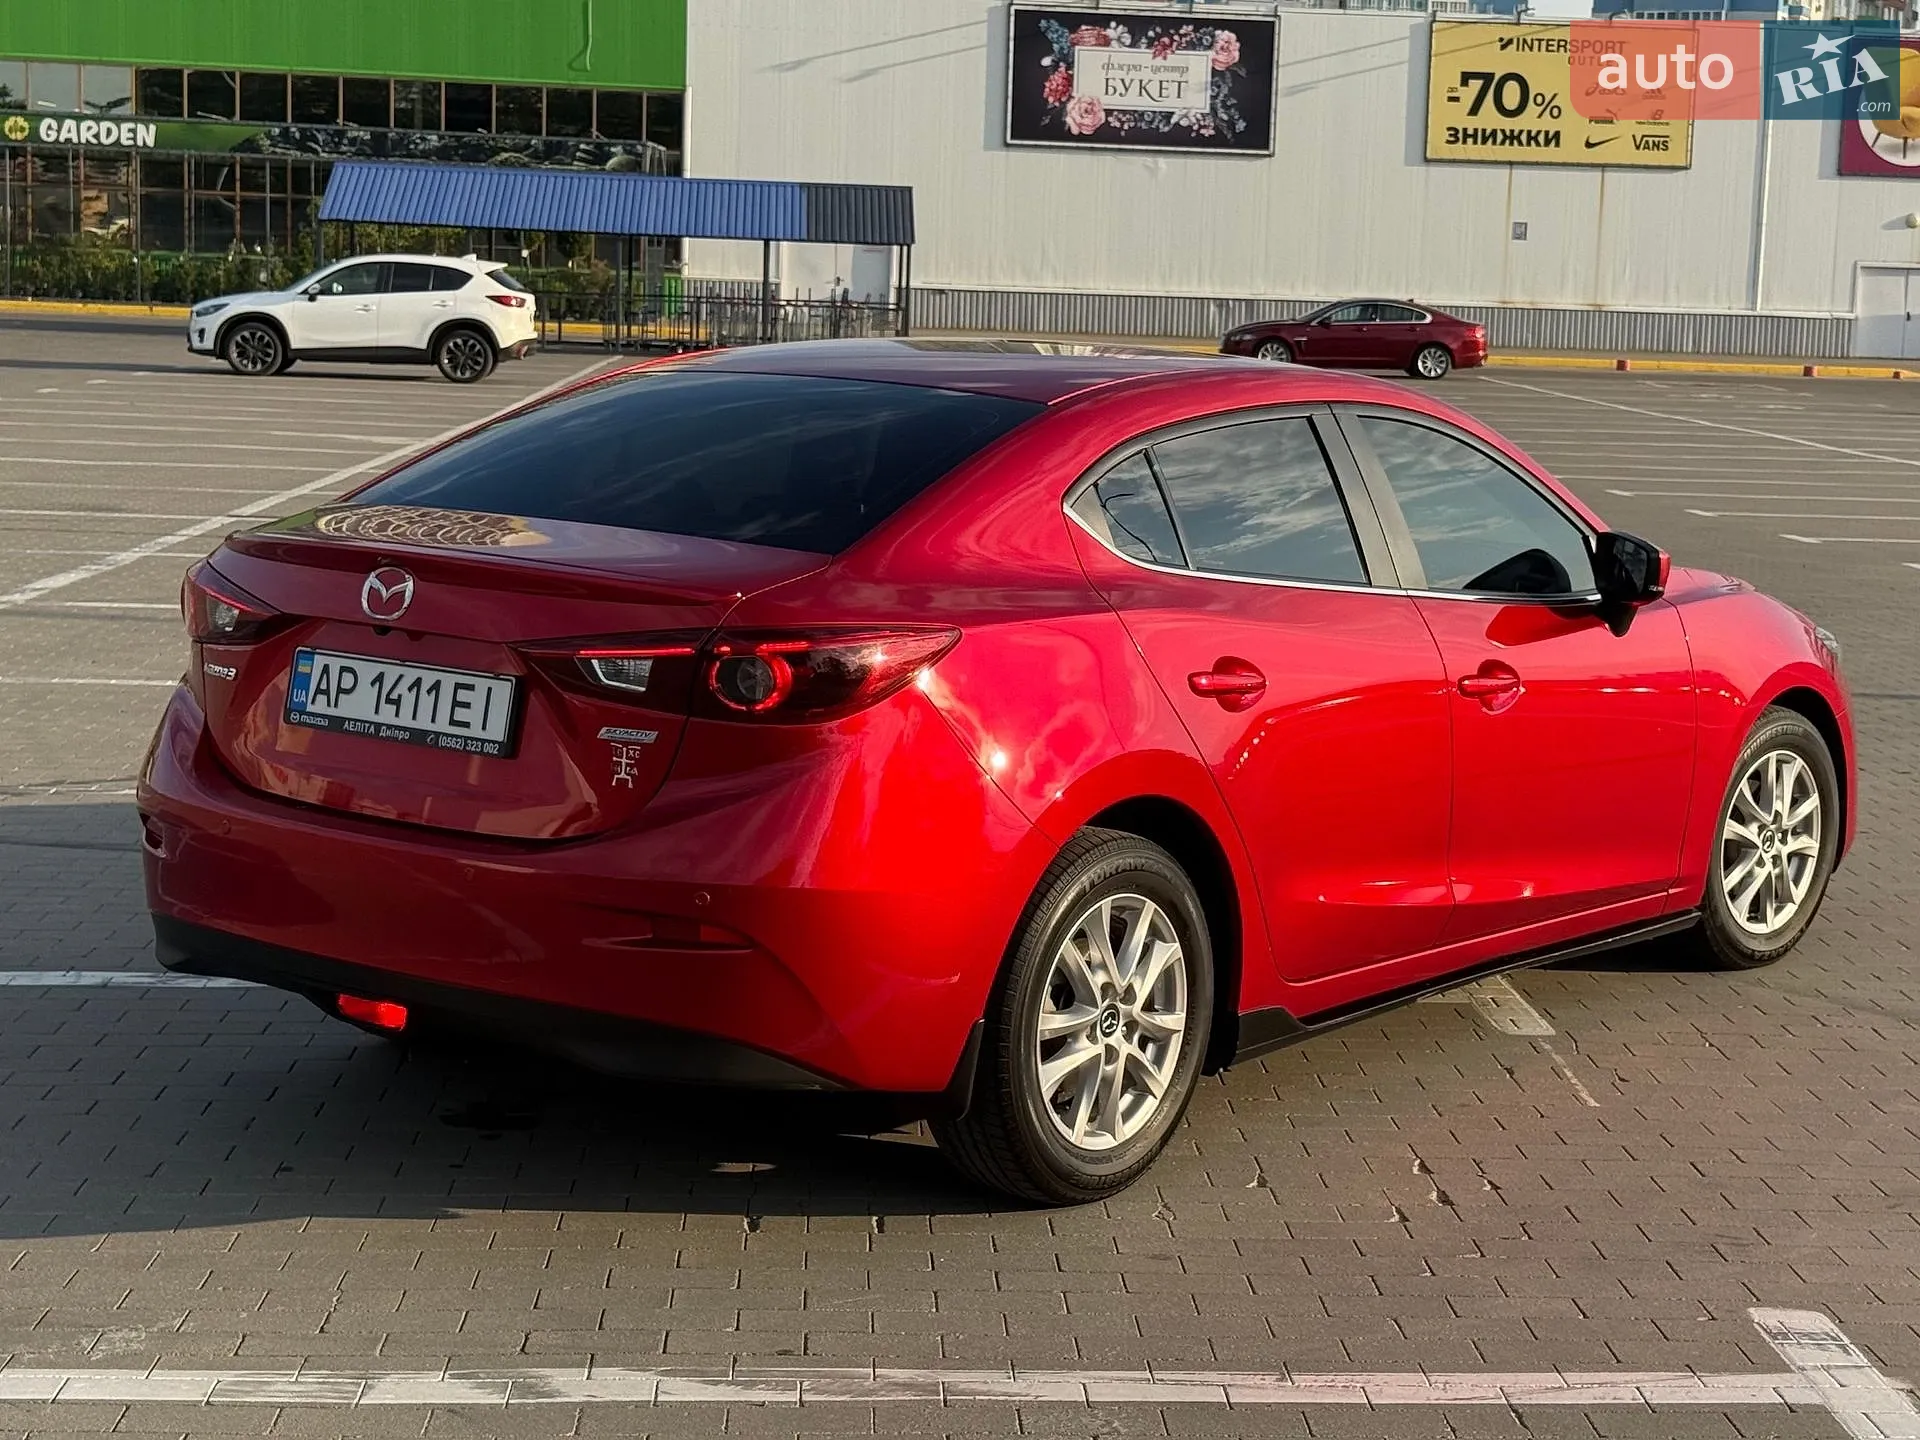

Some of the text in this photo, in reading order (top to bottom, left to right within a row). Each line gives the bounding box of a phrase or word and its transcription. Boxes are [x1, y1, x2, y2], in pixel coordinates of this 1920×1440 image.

[1516, 37, 1627, 55] INTERSPORT
[1568, 56, 1627, 67] OUTLE
[1104, 77, 1188, 102] БУКЕТ
[39, 117, 156, 147] GARDEN
[1445, 126, 1561, 148] ЗНИЖКИ
[1632, 134, 1670, 151] VANS
[293, 688, 306, 703] UA
[310, 663, 493, 731] AP 1411 EI
[343, 719, 375, 735] АЕЛІТА
[438, 734, 499, 754] (0562) 323 002
